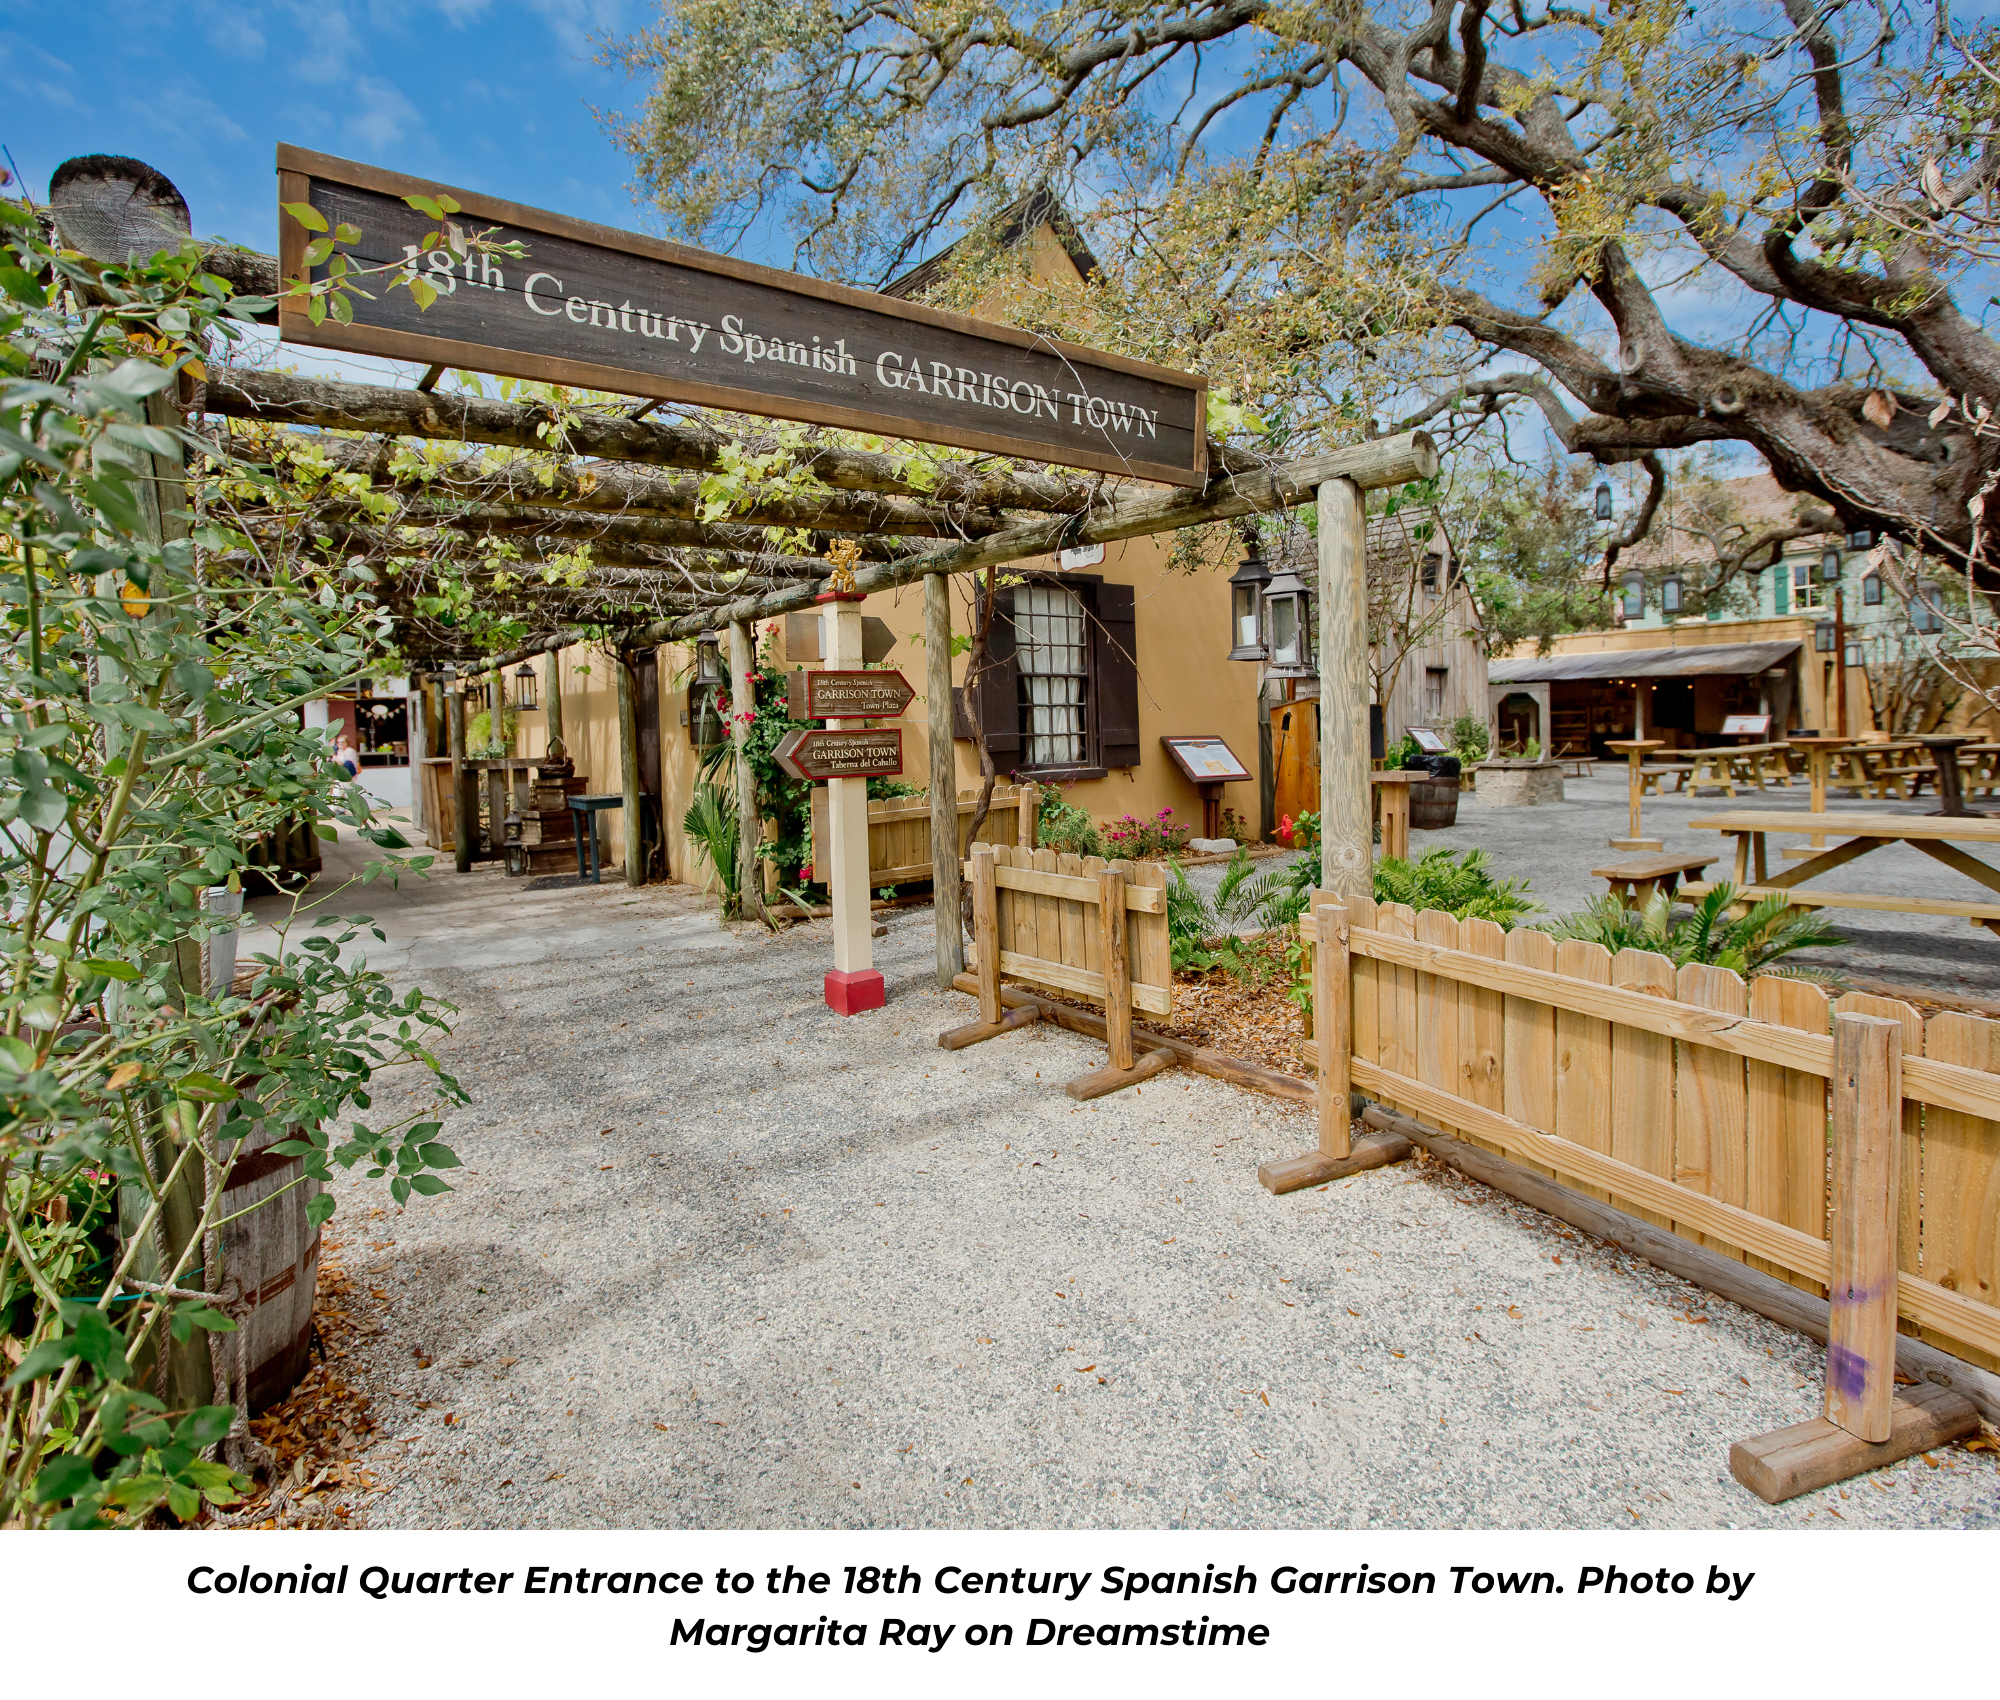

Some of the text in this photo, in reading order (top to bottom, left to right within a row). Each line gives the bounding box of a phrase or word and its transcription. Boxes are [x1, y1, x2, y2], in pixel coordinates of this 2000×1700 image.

[401, 245, 1159, 440] 18th Century Spanish GARRISON TOWN
[817, 678, 873, 688] 18th Century Spanish
[817, 688, 901, 700] GARRISON TOWN
[861, 700, 899, 710] Town Plaza
[812, 738, 869, 748] 18th Century Spanish
[812, 746, 897, 760] GARRISON TOWN
[830, 757, 898, 769] Taberna del Caballo
